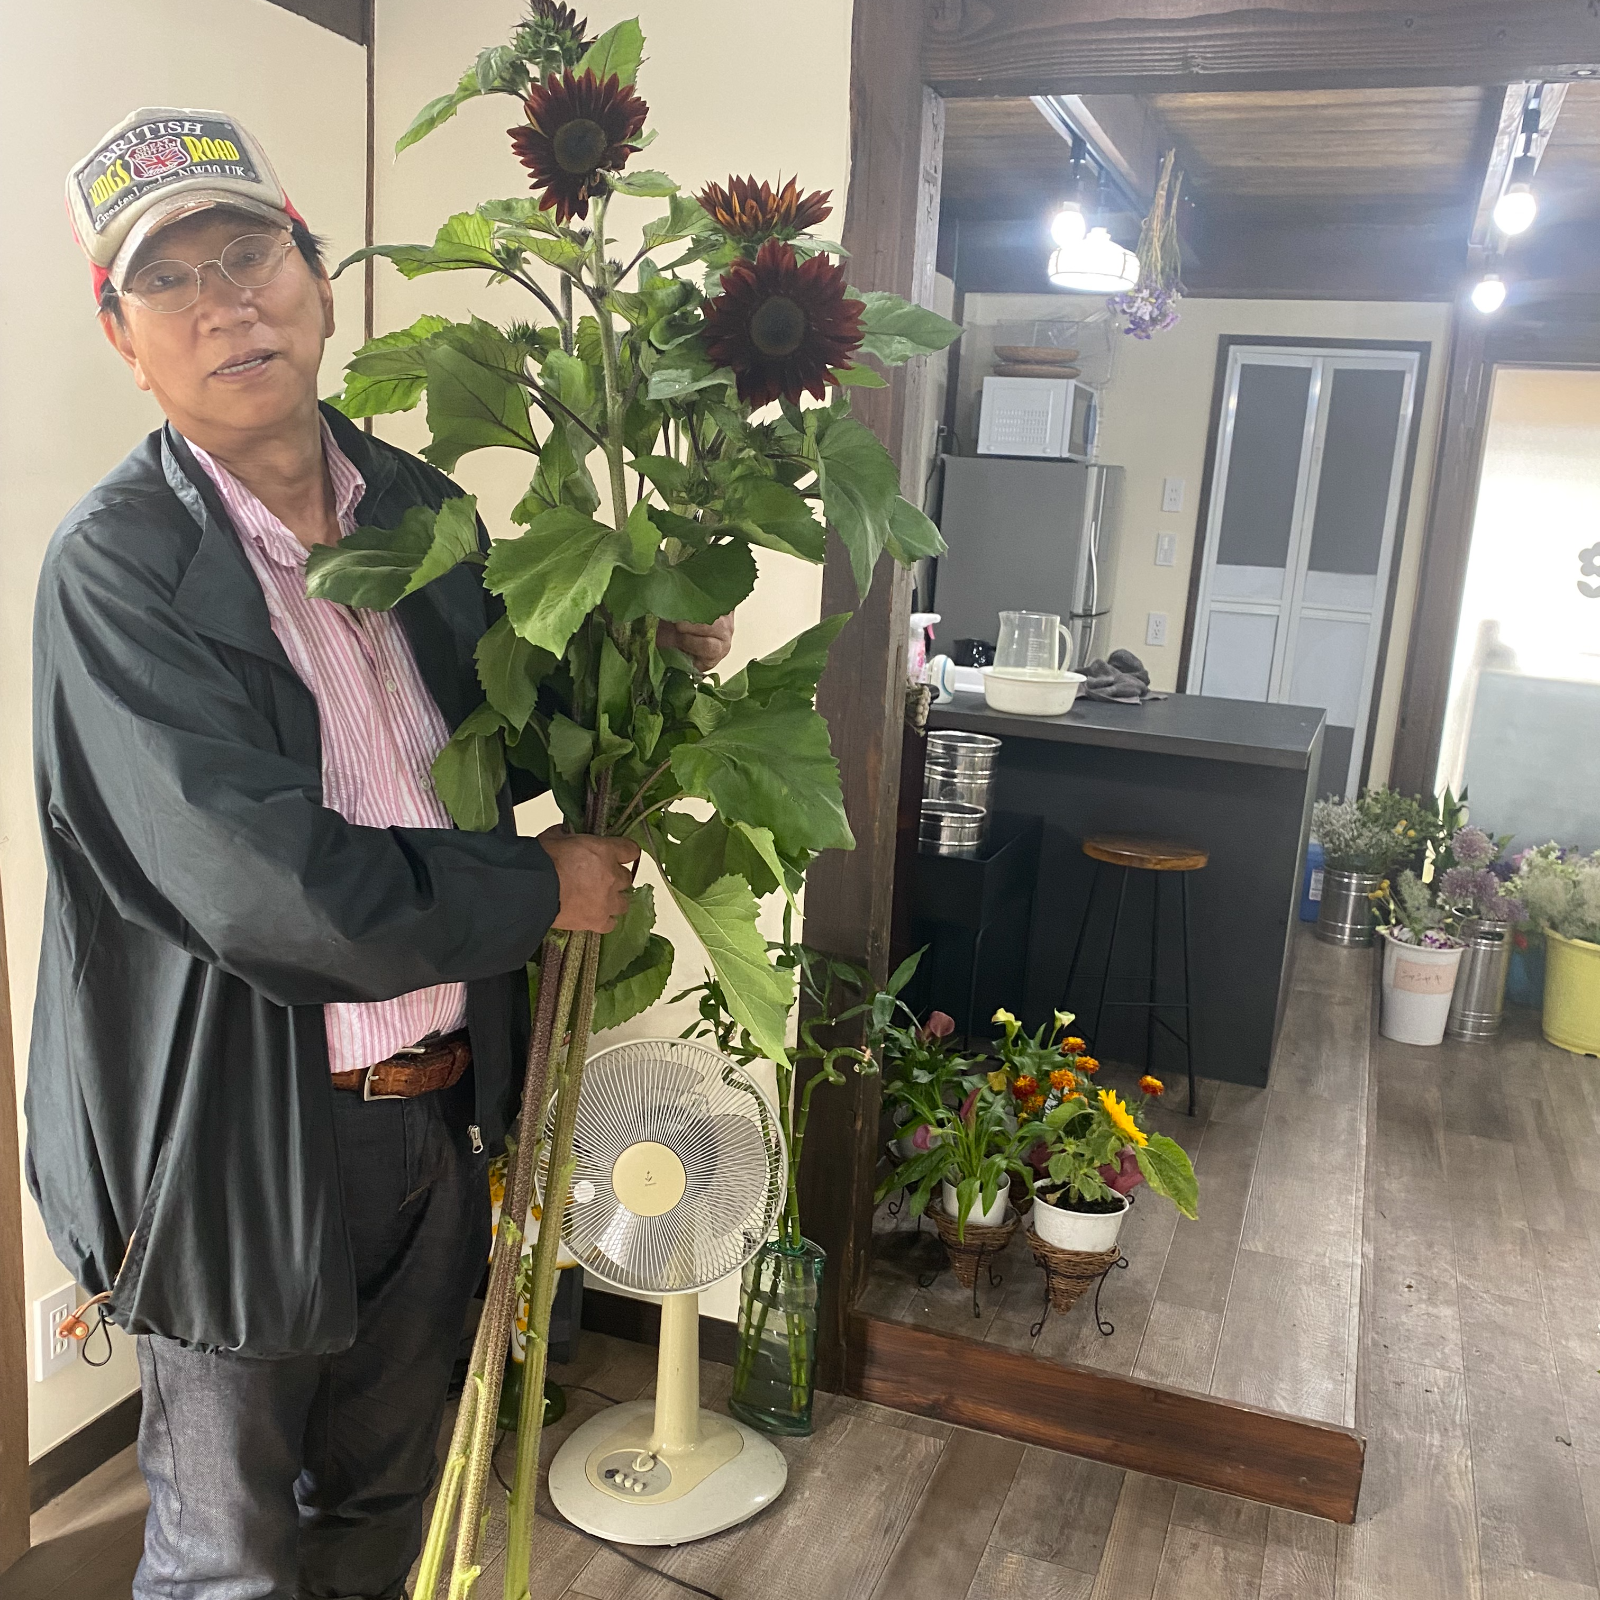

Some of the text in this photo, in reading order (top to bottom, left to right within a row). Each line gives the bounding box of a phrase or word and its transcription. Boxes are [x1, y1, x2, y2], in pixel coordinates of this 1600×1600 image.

[97, 121, 203, 166] BRITISH
[135, 139, 172, 154] GREAT
[89, 136, 240, 208] KINGS ROAD
[224, 165, 246, 177] UK
